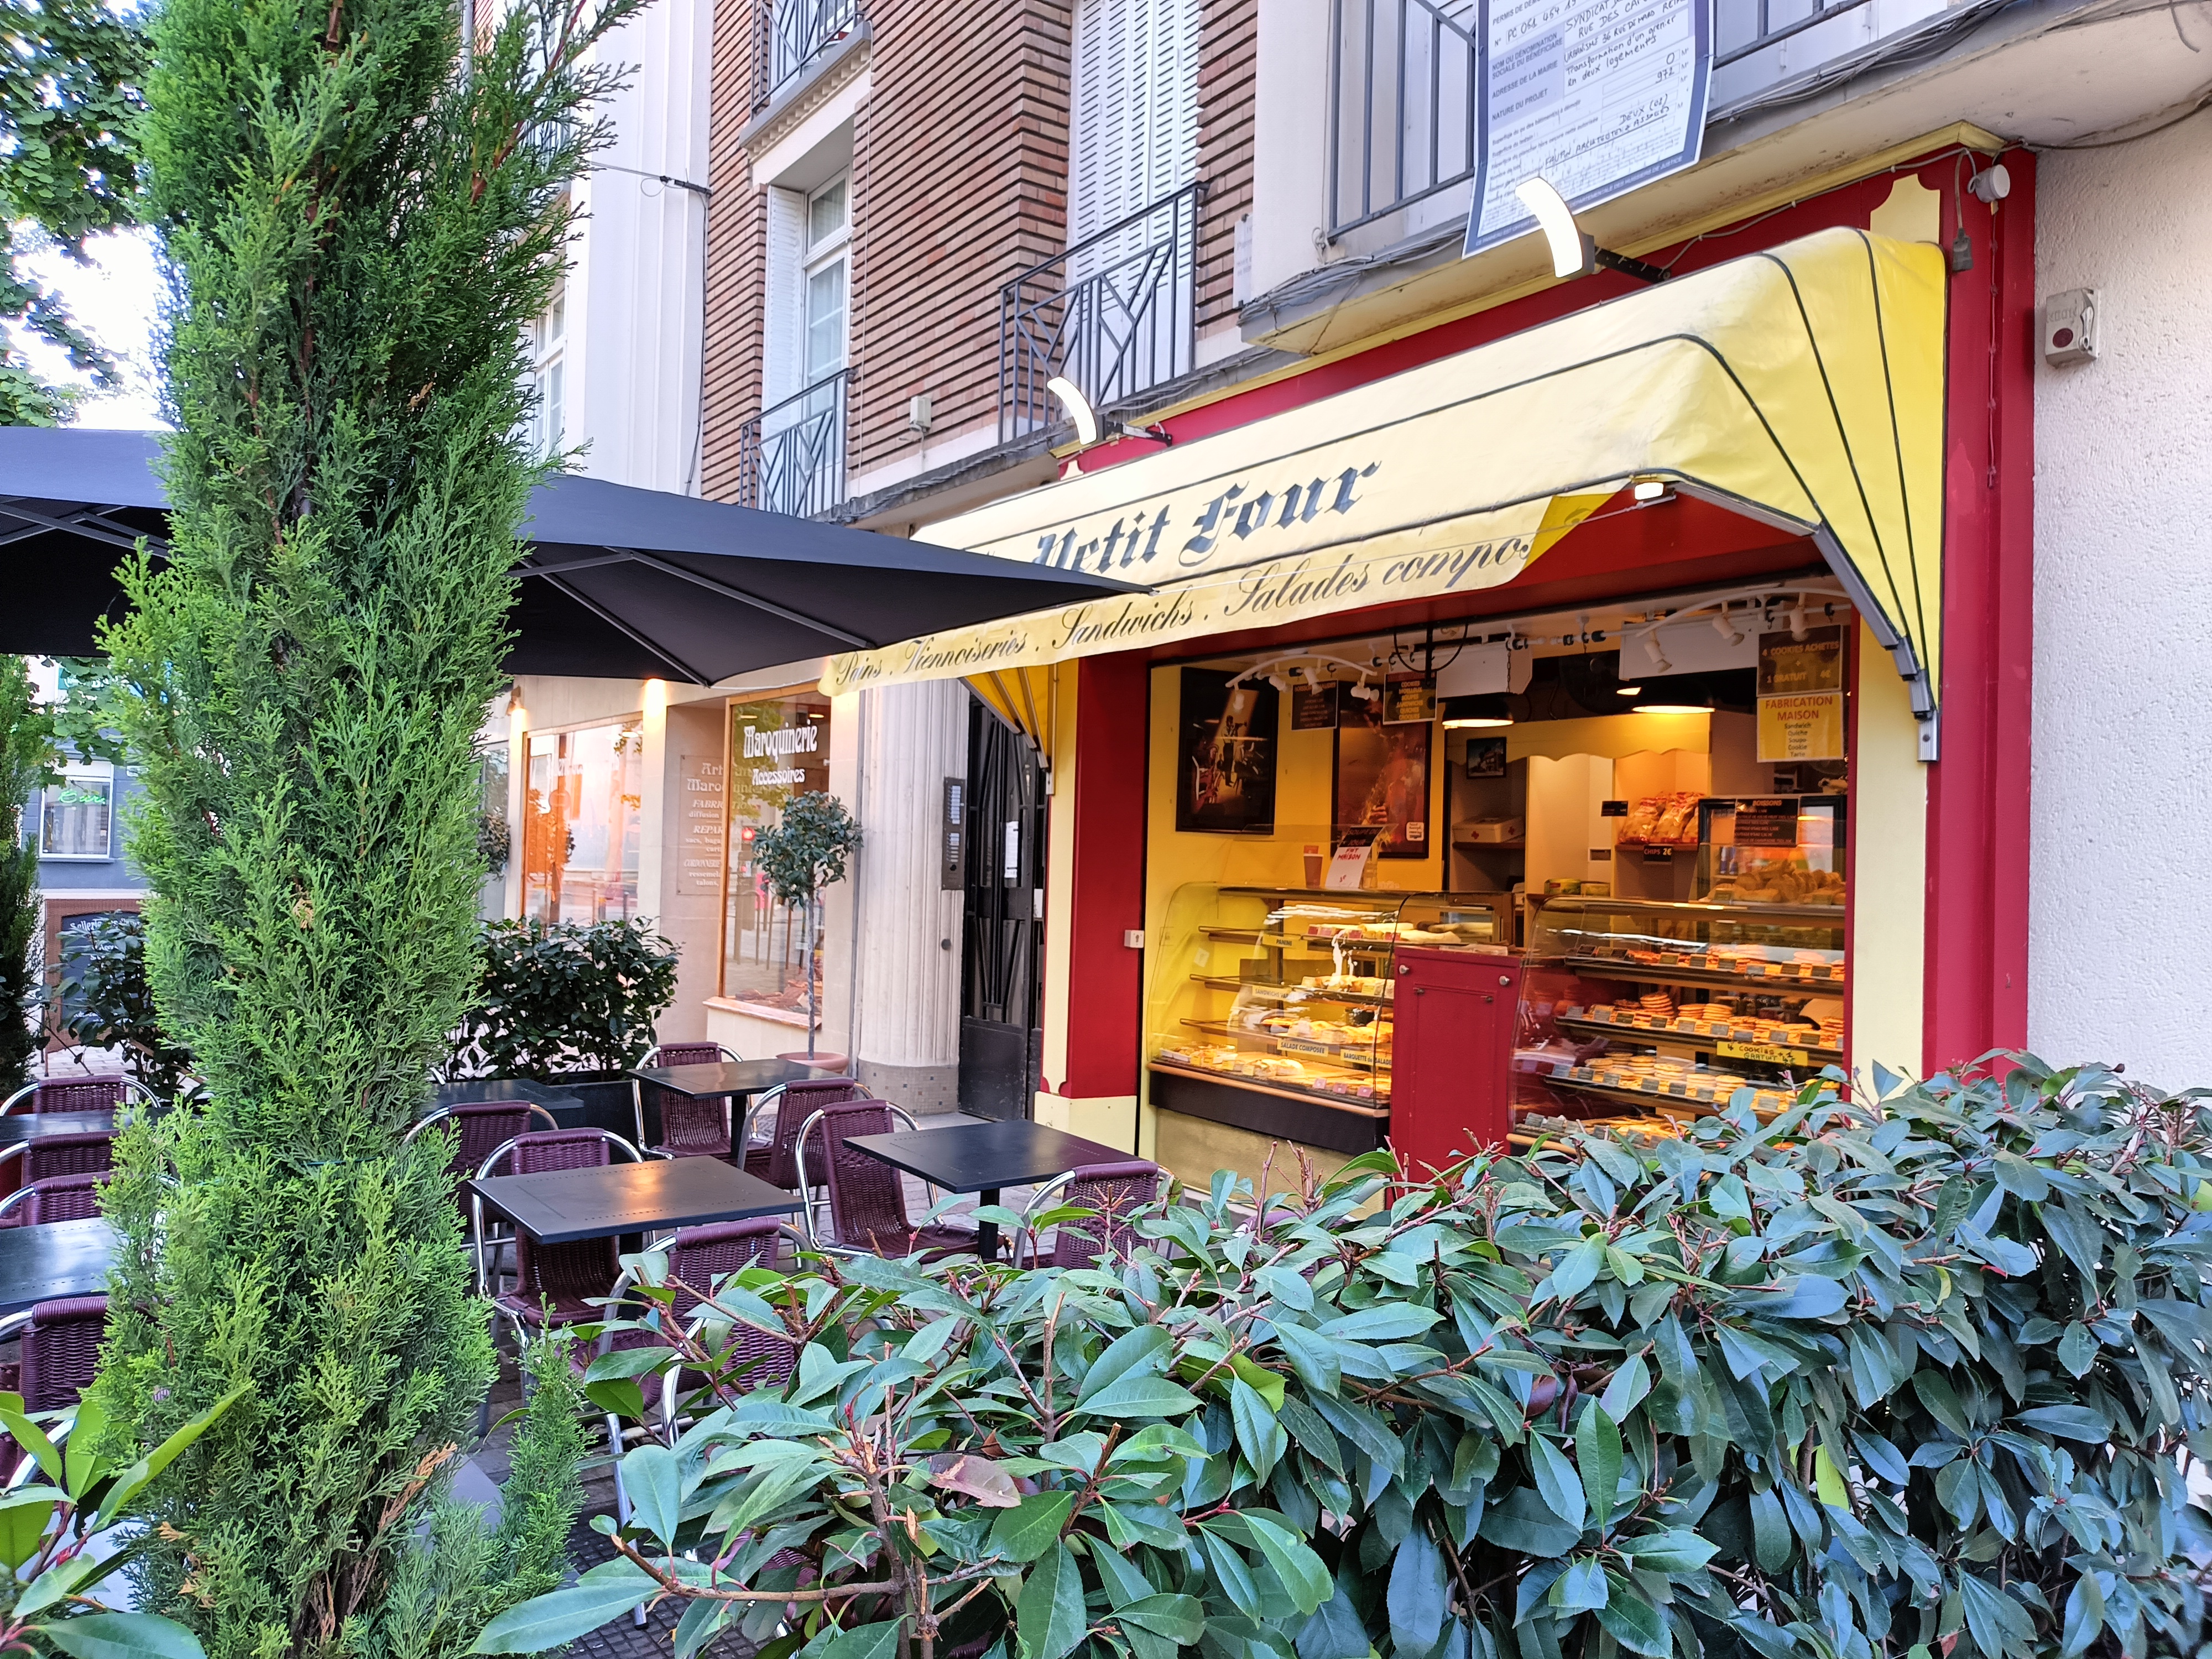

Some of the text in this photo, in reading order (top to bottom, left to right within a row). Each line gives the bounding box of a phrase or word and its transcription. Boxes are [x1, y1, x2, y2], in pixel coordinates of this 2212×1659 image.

[1493, 9, 1514, 25] PERMIS
[1515, 4, 1523, 14] DE
[1565, 1, 1609, 32] SYNDICAT
[1579, 23, 1594, 38] RUE
[1599, 9, 1619, 27] DES
[1492, 32, 1557, 72] NOM OU DÉNOMINATION
[1566, 43, 1624, 75] Transformation
[1648, 15, 1676, 36] grenier
[1492, 63, 1516, 80] SOCIALE
[1517, 57, 1524, 67] DU
[1492, 59, 1558, 99] ADRESSE DE LA MAIRIE
[1582, 64, 1601, 81] deux
[1492, 88, 1548, 121] NATURE DU PROJET
[1178, 460, 1382, 567] Four
[836, 650, 883, 686] Pains
[904, 630, 1028, 675] Viennoiseries
[1052, 585, 1195, 651] Sandwichs
[1224, 553, 1370, 617] Salades
[1770, 645, 1803, 656] COOKIES
[1773, 672, 1807, 684] GRATUIT
[1765, 696, 1833, 709] FABRICATION
[1777, 710, 1819, 721] MAISON
[743, 719, 818, 764] Maroquinerie
[752, 767, 805, 786] Accessoires
[688, 810, 719, 818] diffusion
[1343, 1052, 1367, 1062] BARQUETTE
[1739, 1046, 1775, 1055] COOKIES
[1744, 1052, 1778, 1061] GRATUIT
